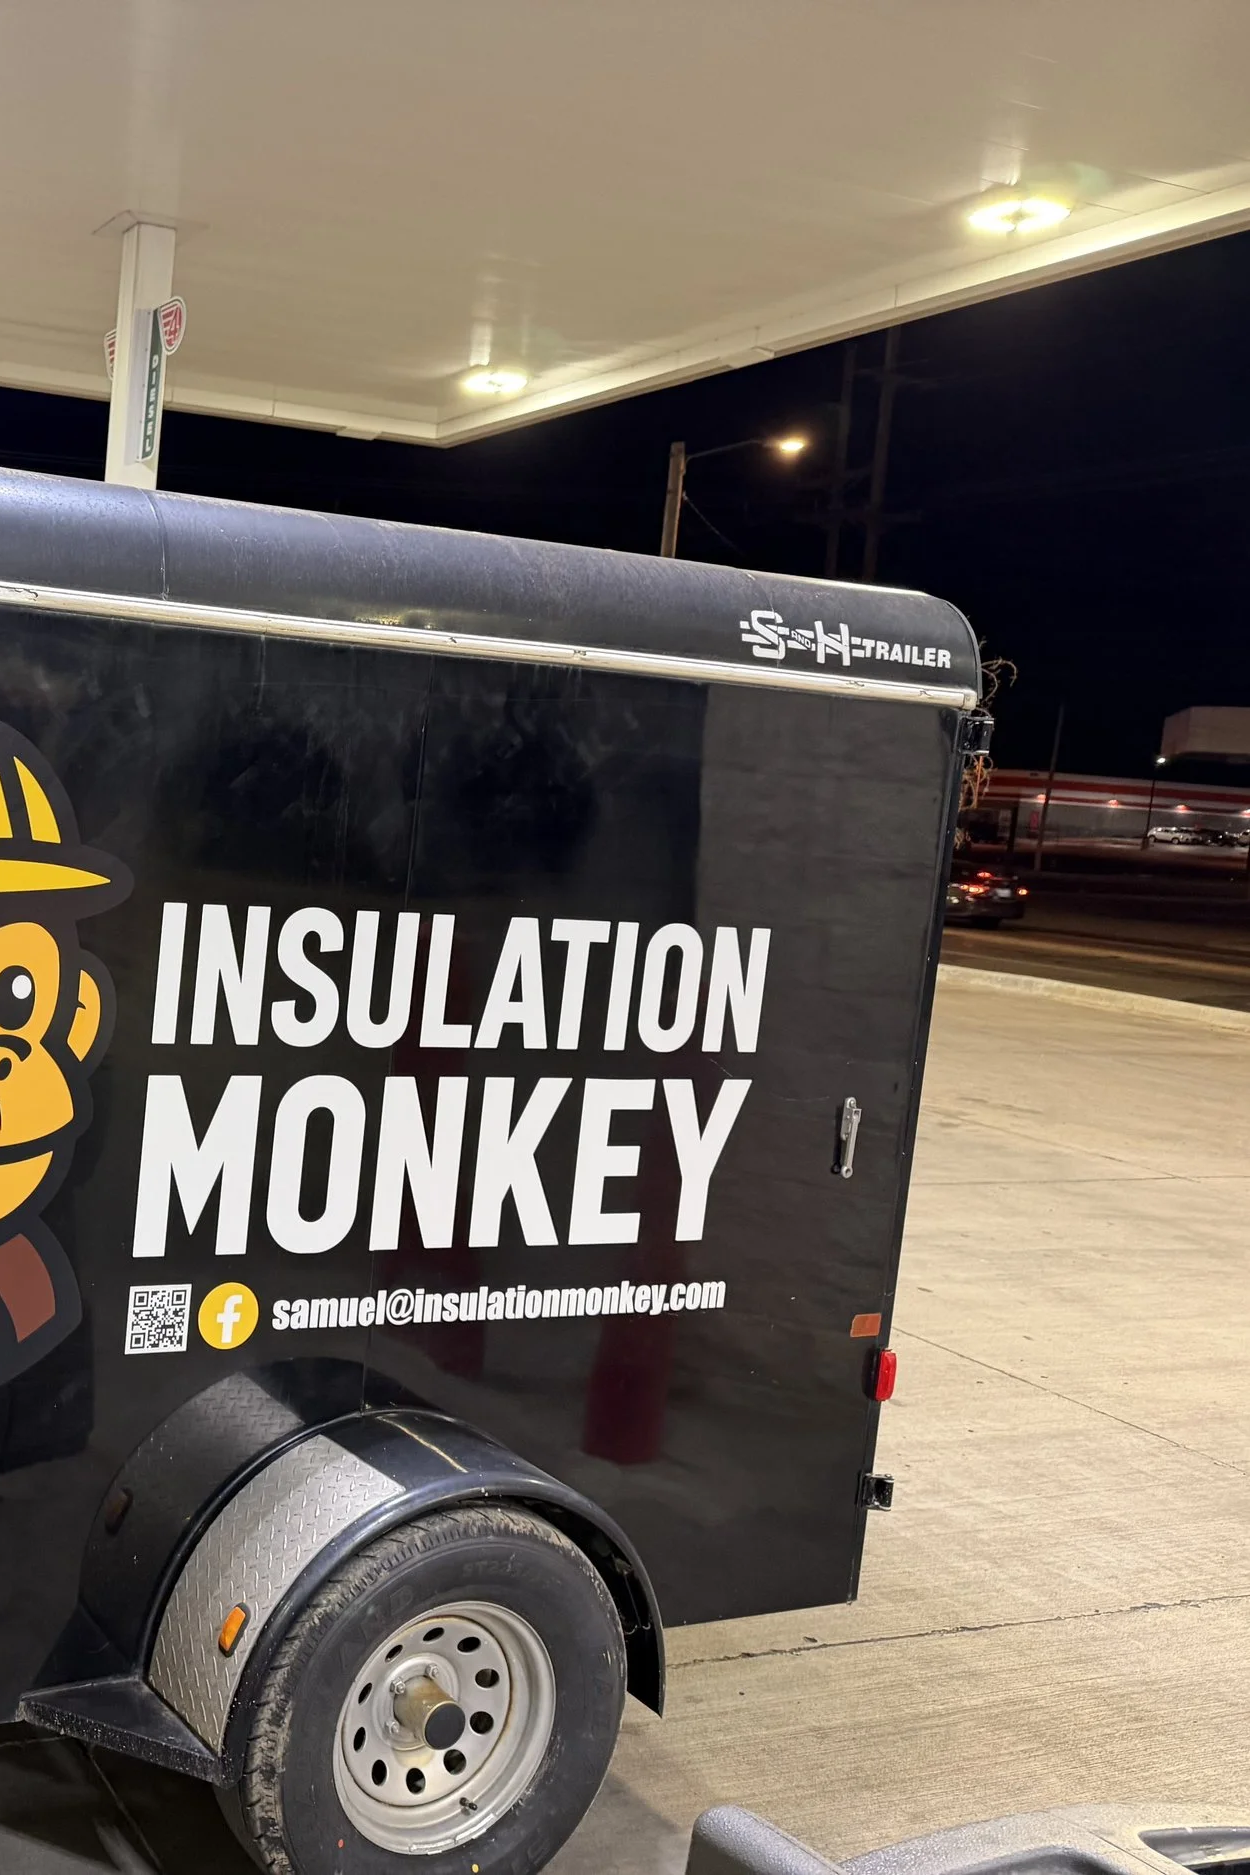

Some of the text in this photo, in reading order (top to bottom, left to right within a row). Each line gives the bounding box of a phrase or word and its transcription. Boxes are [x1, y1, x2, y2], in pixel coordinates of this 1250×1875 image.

[145, 354, 159, 453] DIESEL
[790, 630, 812, 649] AND
[862, 638, 951, 669] TRAILER
[151, 902, 772, 1053] INSULATION
[132, 1074, 753, 1258] MONKEY
[271, 1280, 727, 1331] samuel@insulationmonkey.com
